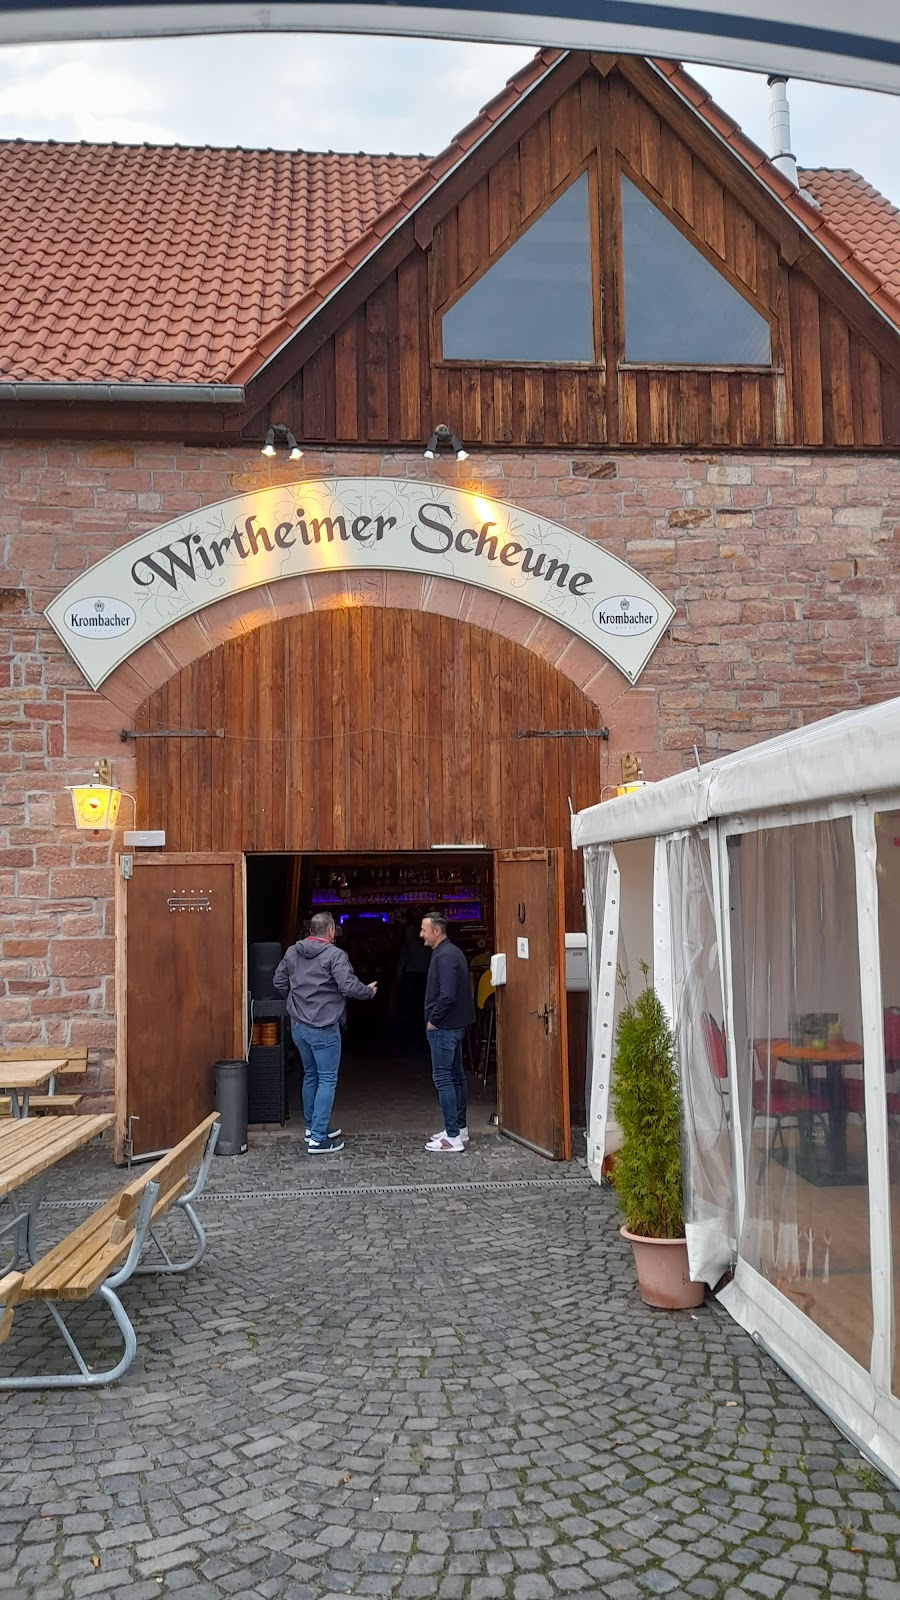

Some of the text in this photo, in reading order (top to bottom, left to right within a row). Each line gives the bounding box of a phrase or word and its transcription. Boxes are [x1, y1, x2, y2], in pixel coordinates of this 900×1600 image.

[131, 502, 594, 596] Wirtheimer Scheune
[71, 613, 131, 627] Krombacher
[599, 611, 654, 624] Krombacher
